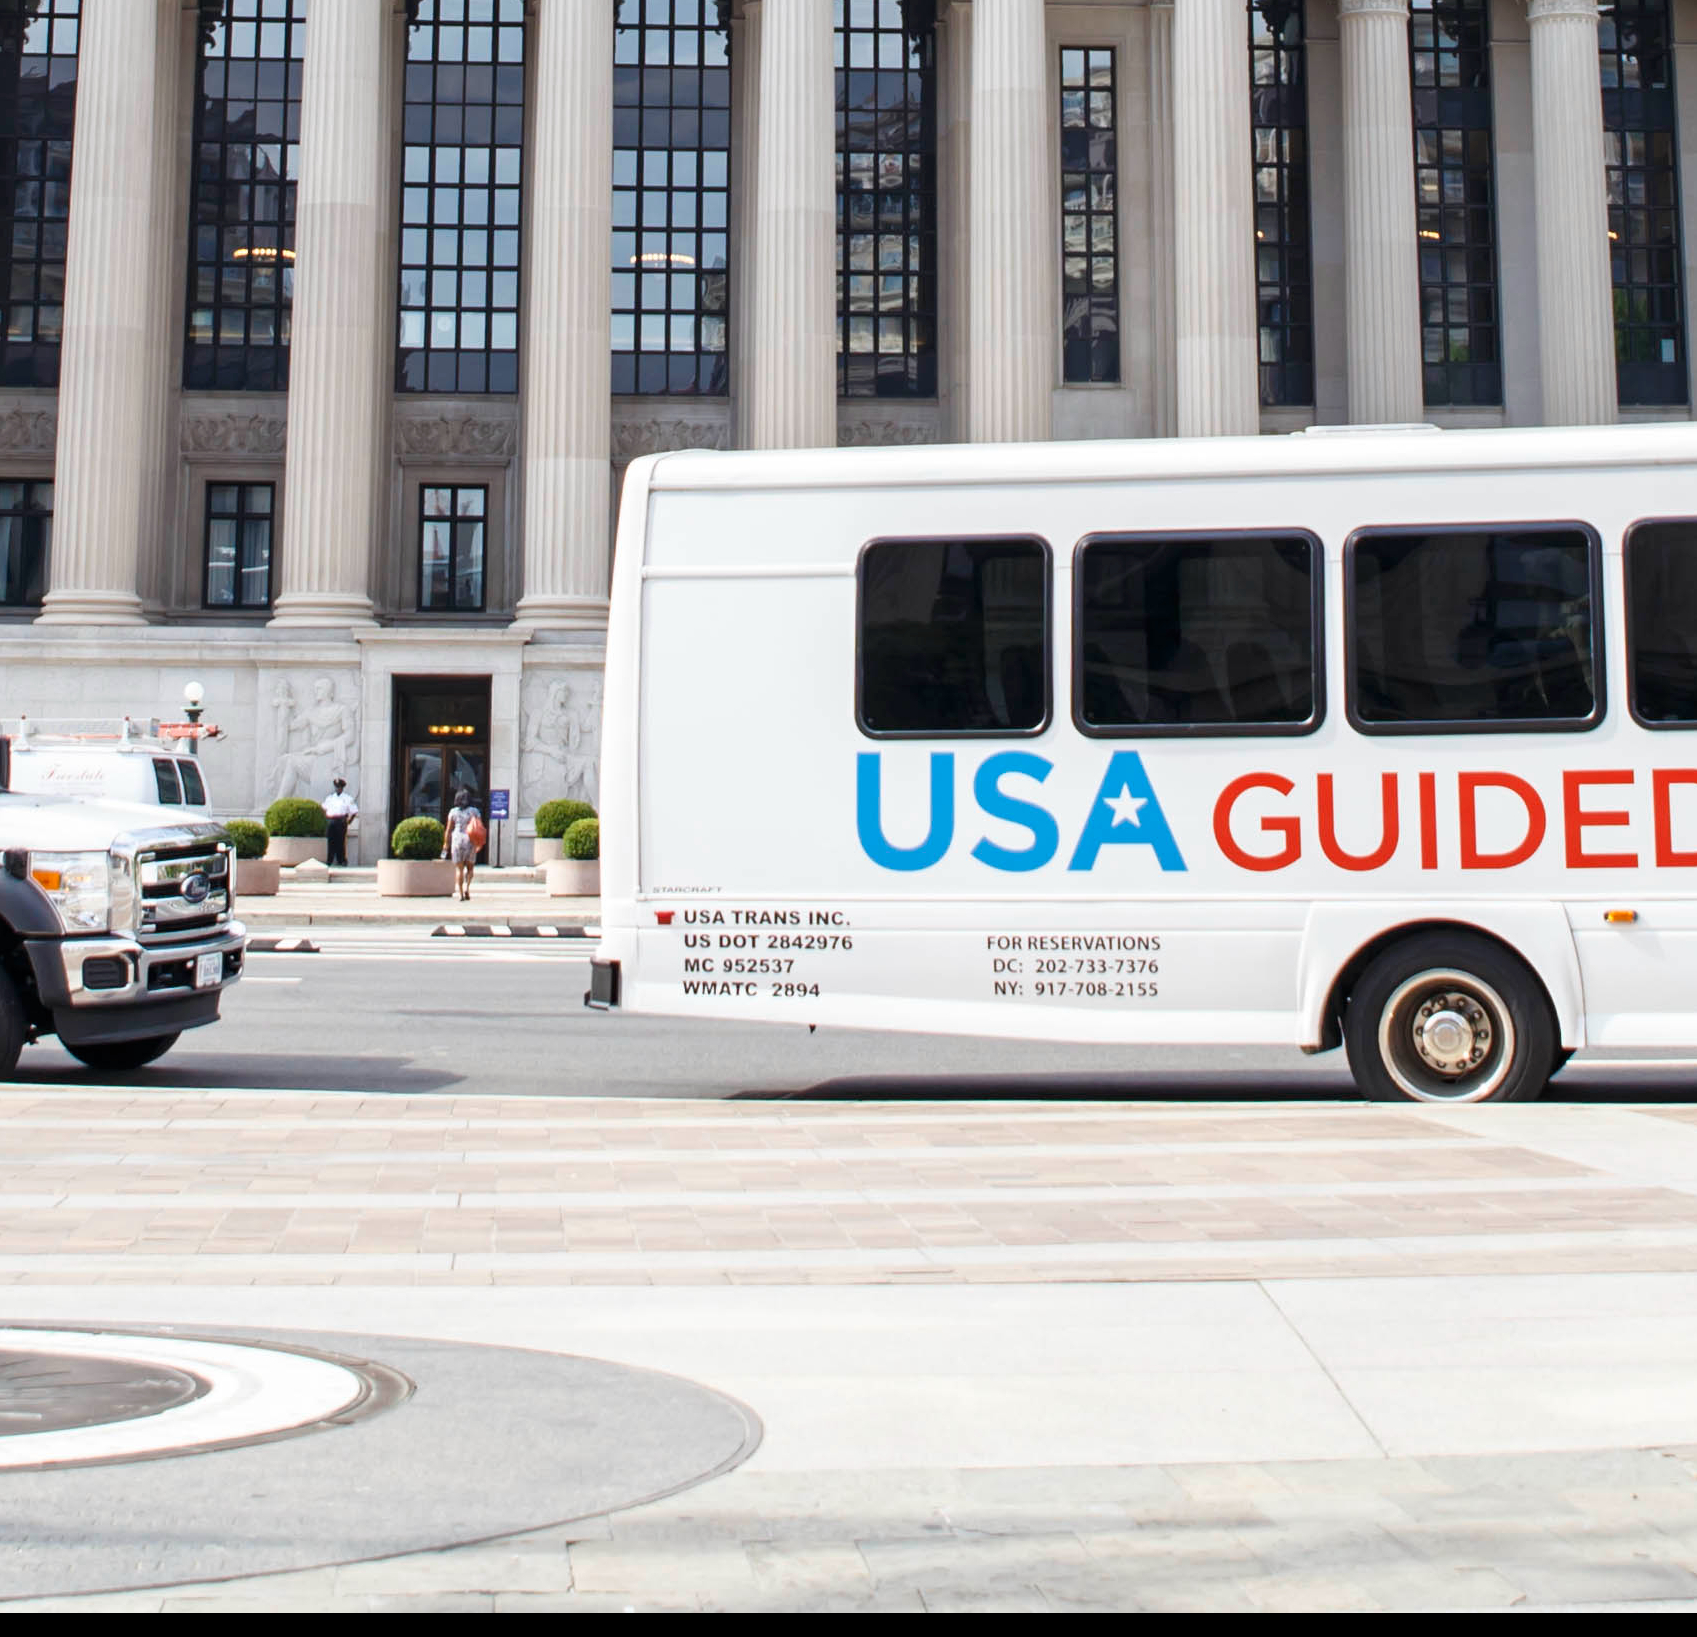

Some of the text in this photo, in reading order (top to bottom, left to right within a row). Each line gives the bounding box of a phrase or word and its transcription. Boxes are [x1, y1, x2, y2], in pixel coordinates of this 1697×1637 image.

[857, 751, 1187, 872] USA
[684, 910, 851, 926] USA TRANS INC.
[684, 934, 853, 950] US DOT 2842976
[987, 936, 1161, 951] FOR RESERVATIONS
[684, 958, 795, 973] MC 952537
[993, 958, 1159, 974] DC: 202-733-7376
[683, 981, 821, 998] WMATC 2894
[994, 981, 1159, 997] NY: 917-708-2155
